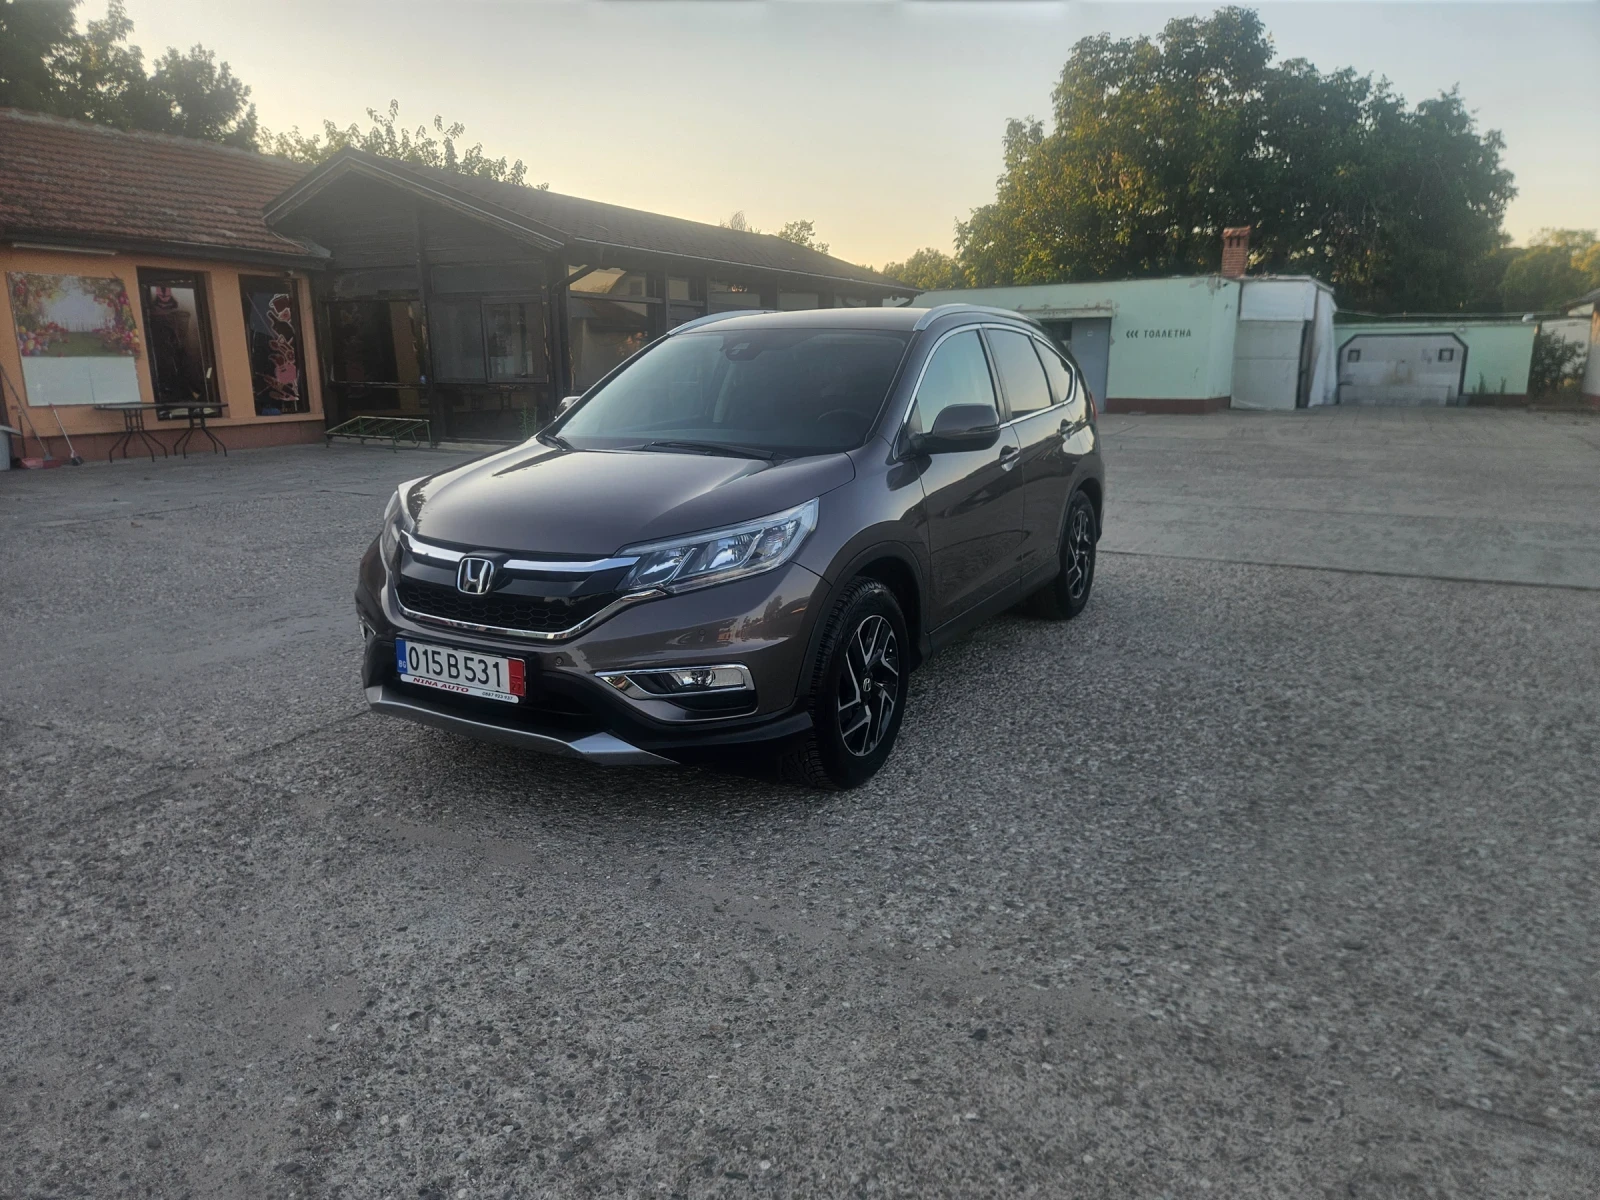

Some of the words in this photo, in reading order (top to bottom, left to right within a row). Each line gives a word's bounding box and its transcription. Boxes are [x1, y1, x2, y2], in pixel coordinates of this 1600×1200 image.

[398, 660, 407, 668] BG
[408, 646, 501, 688] 015B531
[413, 677, 438, 687] NINA
[440, 683, 469, 693] AUTO
